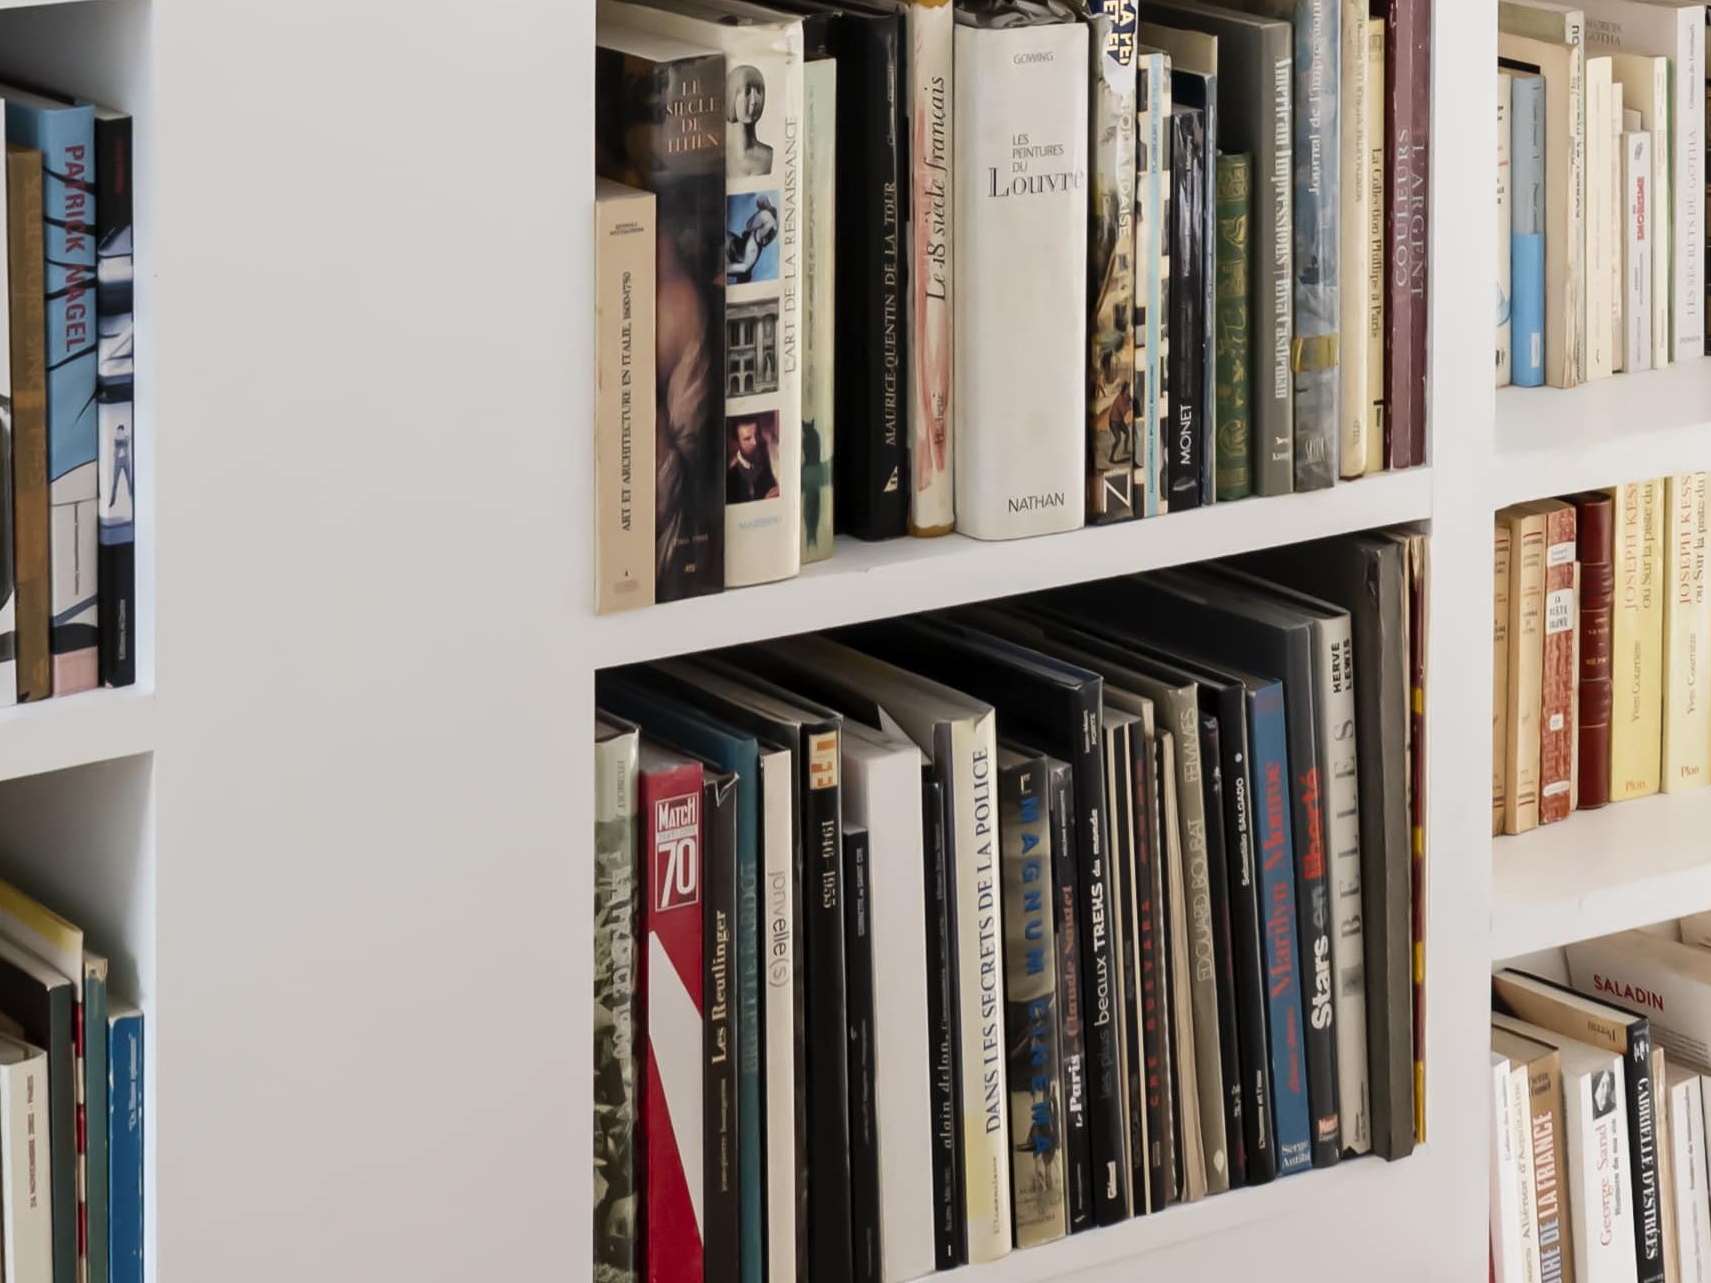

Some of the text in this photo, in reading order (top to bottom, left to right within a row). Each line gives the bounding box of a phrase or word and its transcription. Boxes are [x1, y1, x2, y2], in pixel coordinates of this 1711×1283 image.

[1012, 134, 1030, 146] LES
[1012, 144, 1065, 160] PEINTURES
[1012, 159, 1029, 173] DU
[987, 166, 1087, 199] Louvre
[1394, 127, 1408, 288] COULEURS
[63, 144, 87, 354] PATRICK NAGEL
[782, 115, 799, 374] L'ART DE LA RENAISSANCE
[1410, 144, 1427, 299] L'ARGENT
[1180, 402, 1192, 465] MONET
[1008, 491, 1065, 514] NATHAN
[658, 838, 697, 909] 70
[972, 745, 1002, 1136] DANS LES SECRETS DE LA POLICE
[1592, 974, 1665, 1012] SALADIN
[1068, 1054, 1083, 1113] Paris
